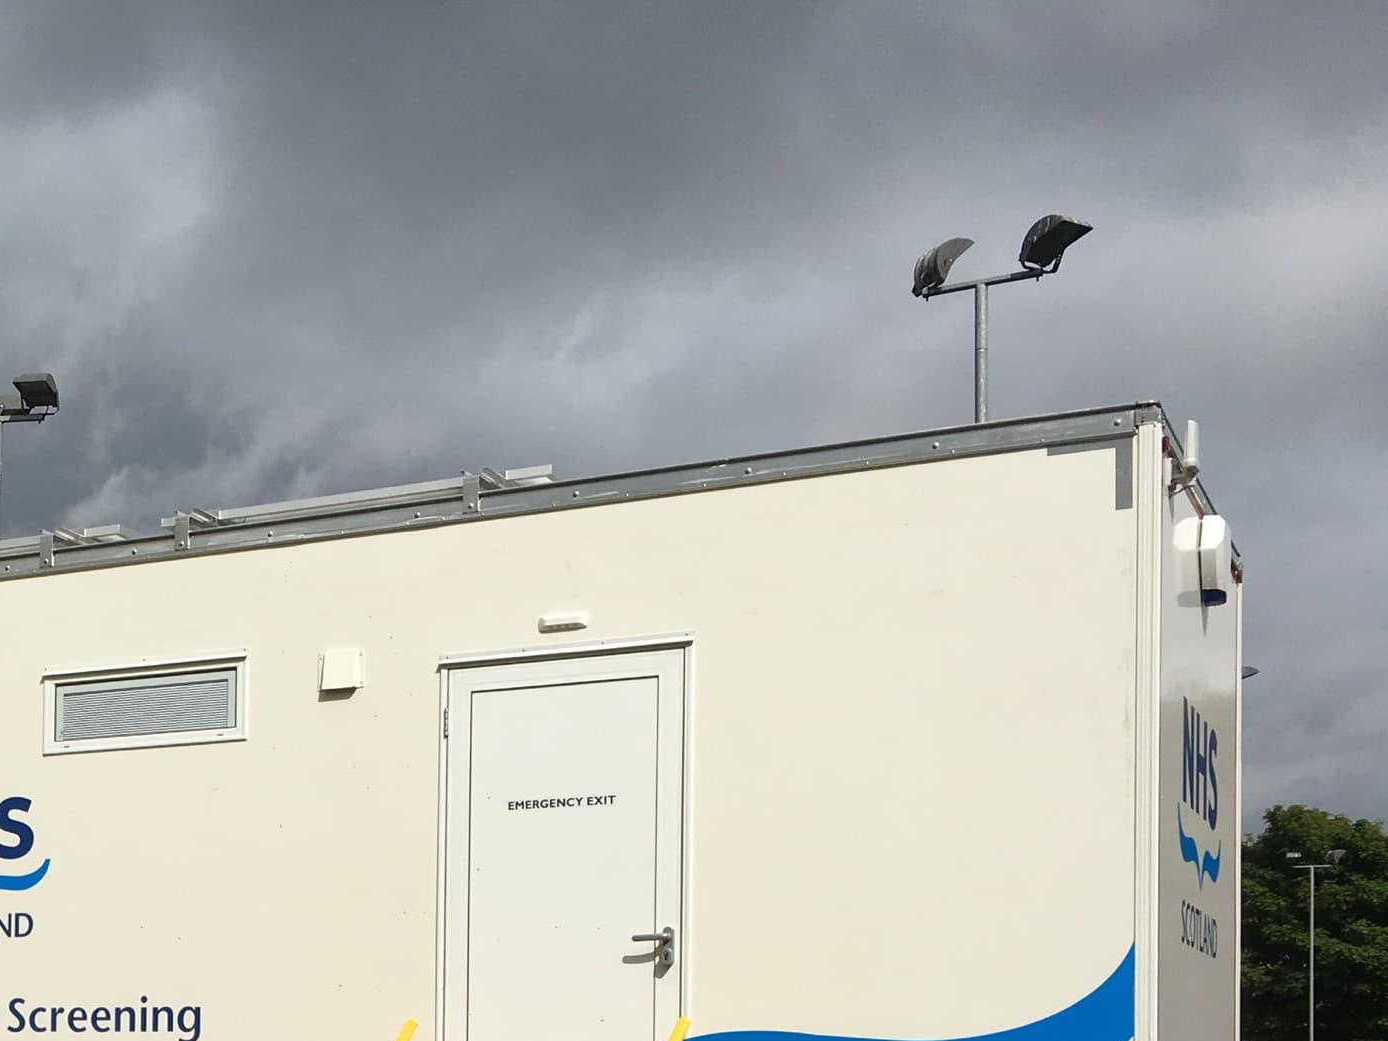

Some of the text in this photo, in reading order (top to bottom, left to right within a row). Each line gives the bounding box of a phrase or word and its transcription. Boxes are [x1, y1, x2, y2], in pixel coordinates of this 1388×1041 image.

[1182, 695, 1218, 831] NHS
[507, 794, 617, 811] EMERGENCY EXIT
[1181, 898, 1218, 959] SCOTLAND
